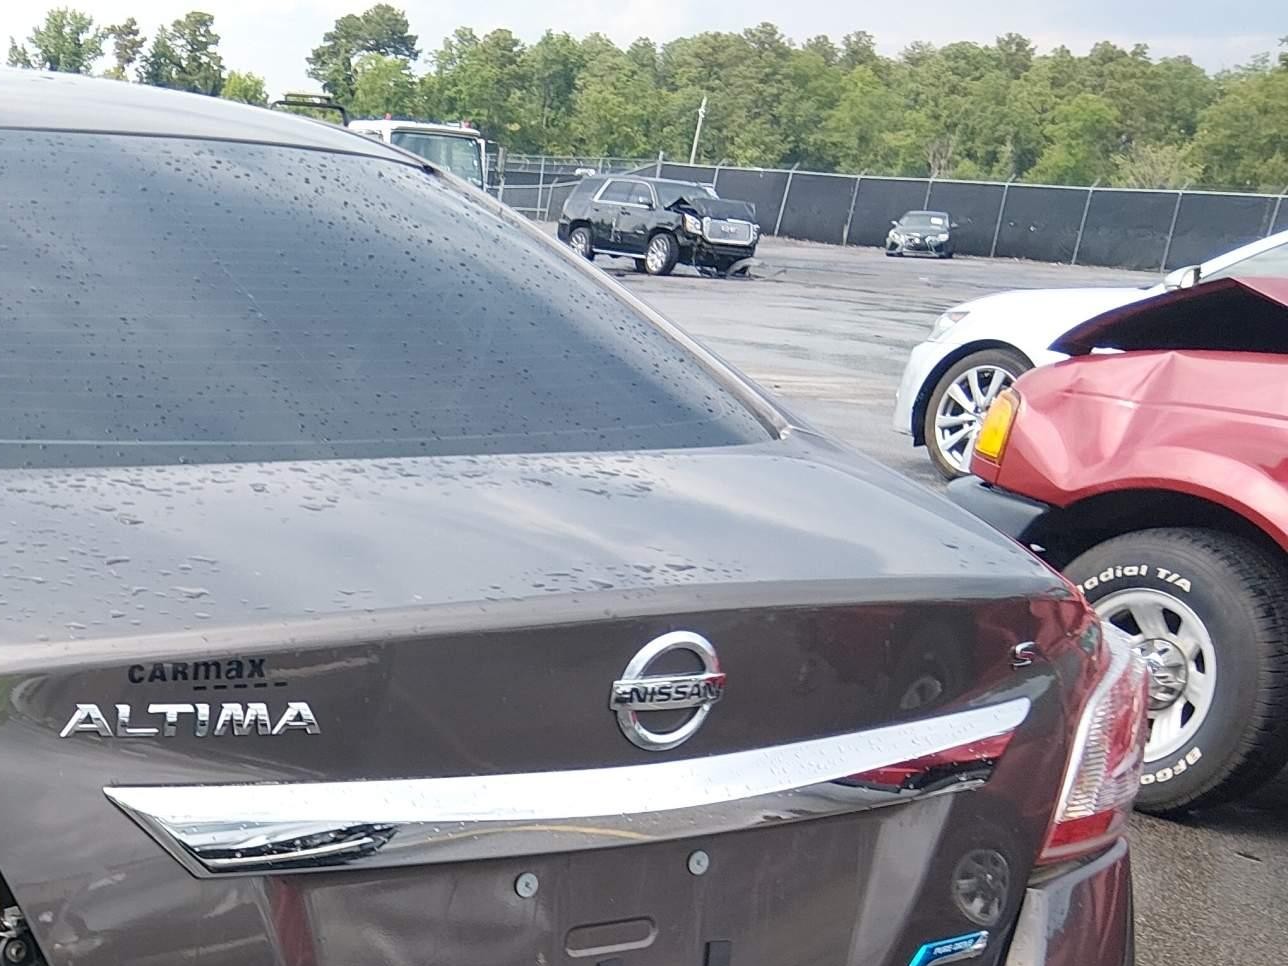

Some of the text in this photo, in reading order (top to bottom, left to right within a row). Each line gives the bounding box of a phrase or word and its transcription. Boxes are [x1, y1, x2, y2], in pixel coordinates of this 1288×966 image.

[1155, 567, 1192, 593] T/A
[1012, 641, 1035, 669] S
[629, 681, 720, 704] NISSAN
[59, 701, 321, 738] ALTIMA
